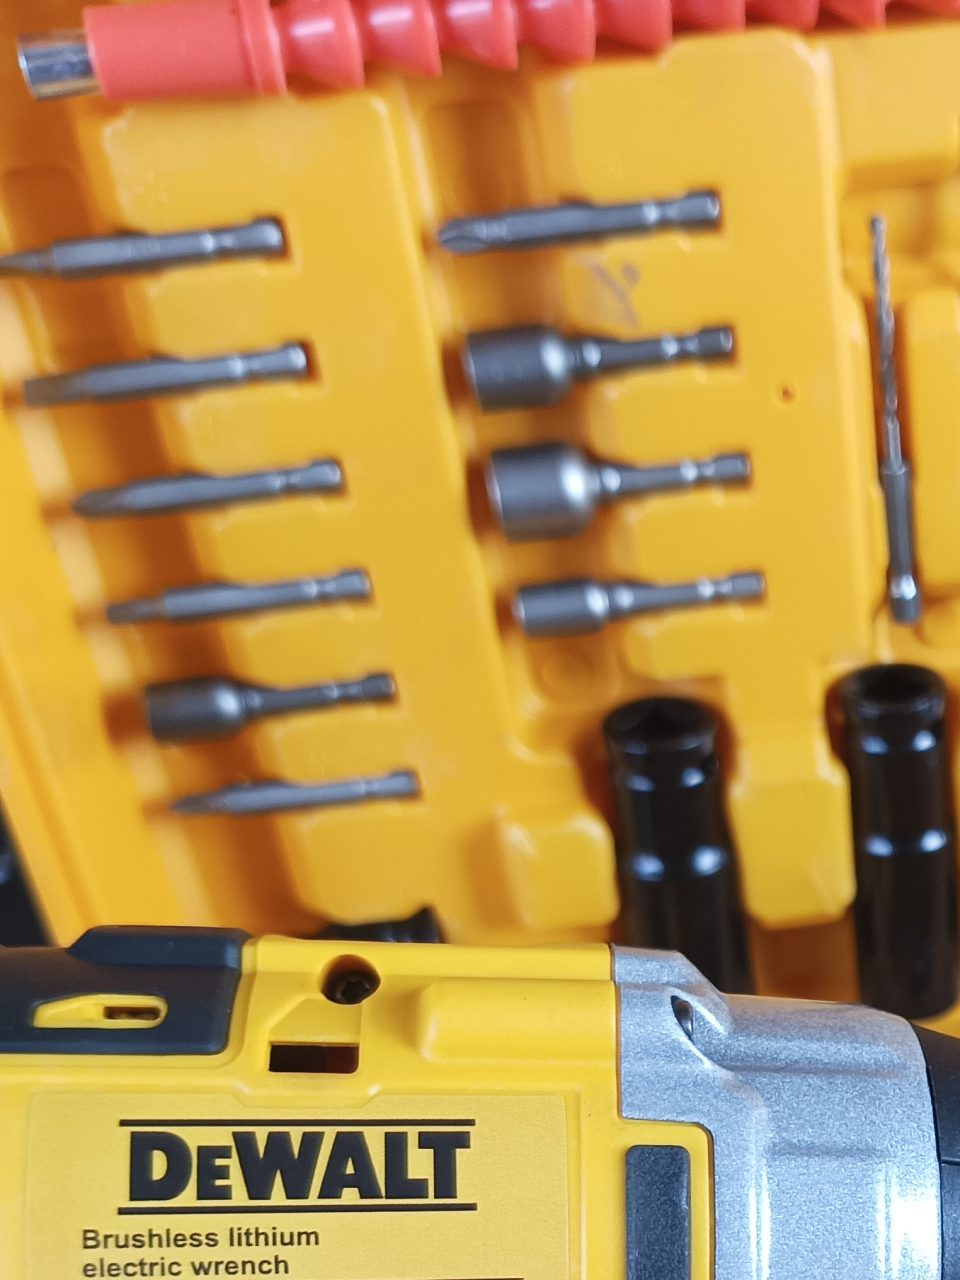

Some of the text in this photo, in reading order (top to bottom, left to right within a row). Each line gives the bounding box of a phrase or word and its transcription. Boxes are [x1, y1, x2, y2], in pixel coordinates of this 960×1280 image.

[81, 1226, 320, 1250] Brushless lithium
[82, 1255, 290, 1279] electric wrench
